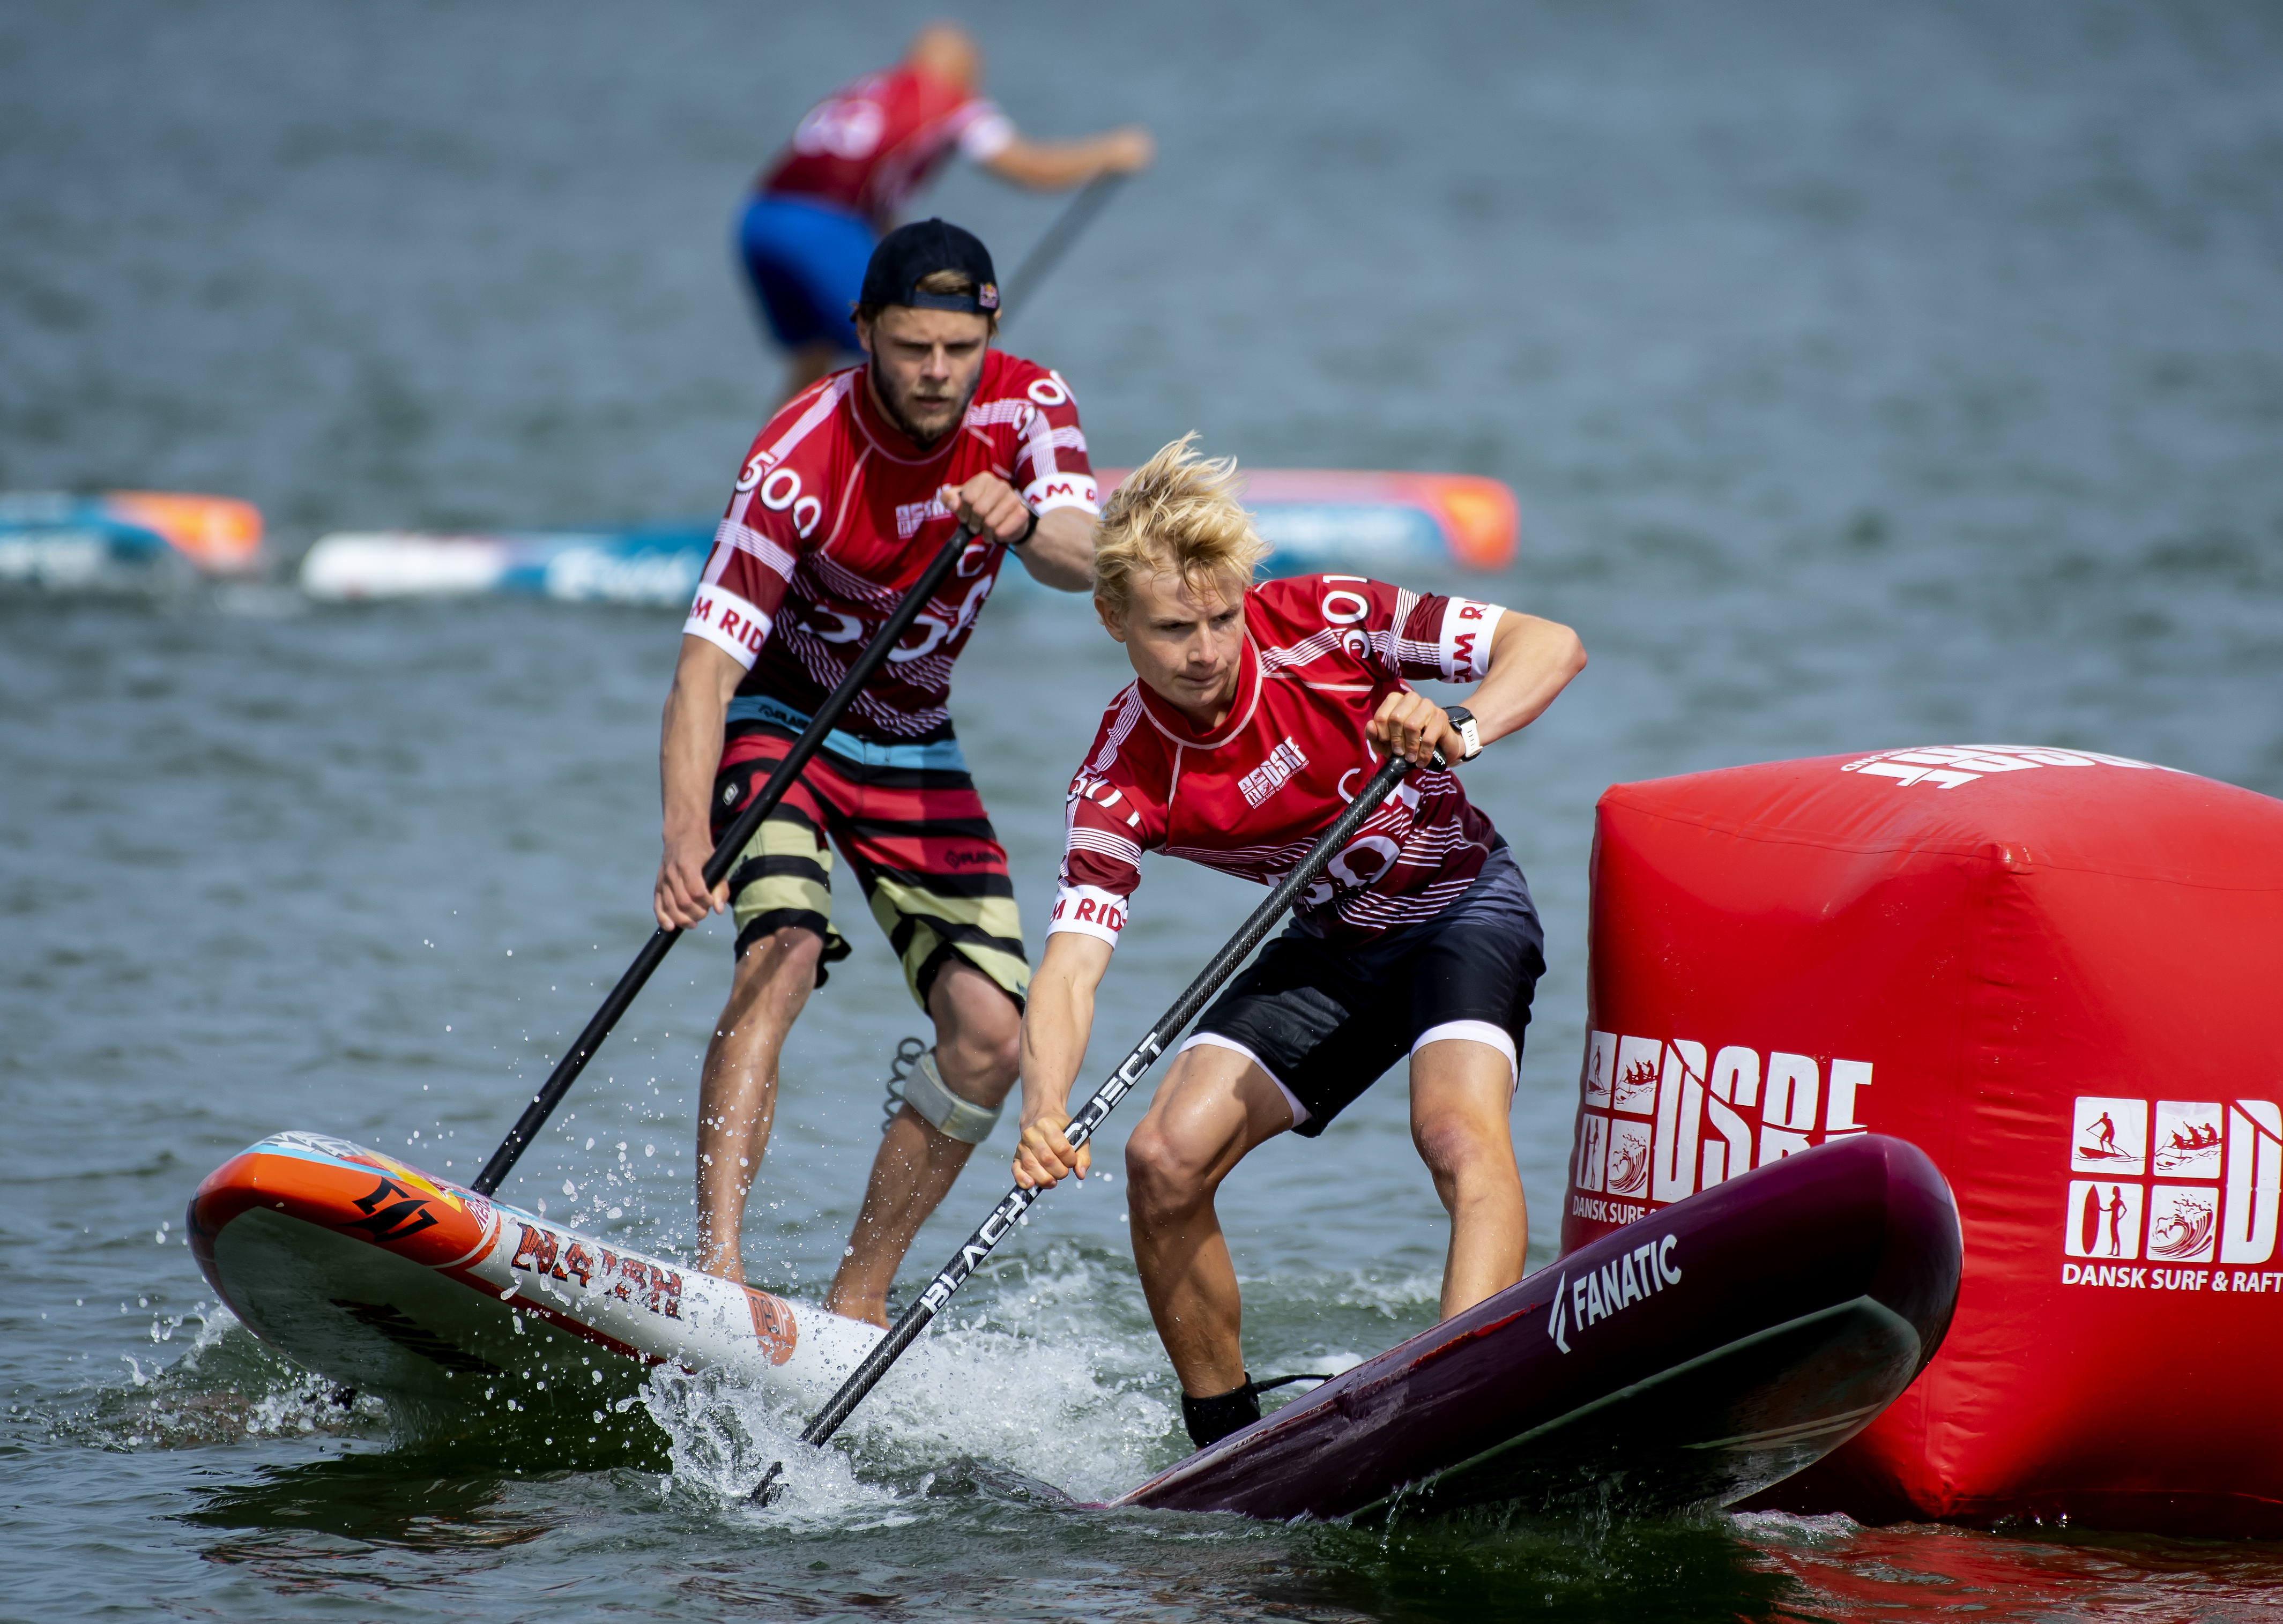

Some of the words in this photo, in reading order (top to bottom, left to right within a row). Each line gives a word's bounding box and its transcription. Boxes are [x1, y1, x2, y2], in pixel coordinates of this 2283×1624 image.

[735, 451, 822, 539] 500
[690, 597, 713, 622] M
[1459, 600, 1490, 620] R
[1252, 796, 1267, 810] DANSK
[1266, 789, 1276, 799] SURF
[1050, 899, 1067, 923] M
[1074, 898, 1127, 932] RID
[1572, 1195, 1608, 1223] DANSK
[1609, 1203, 1646, 1225] SURF
[920, 1191, 1028, 1315] BLACK
[1573, 1234, 1682, 1332] FANATIC
[2062, 1263, 2147, 1289] DANSK
[2151, 1268, 2208, 1291] SURF
[2211, 1271, 2229, 1292] &
[2232, 1271, 2283, 1293] RAFT
